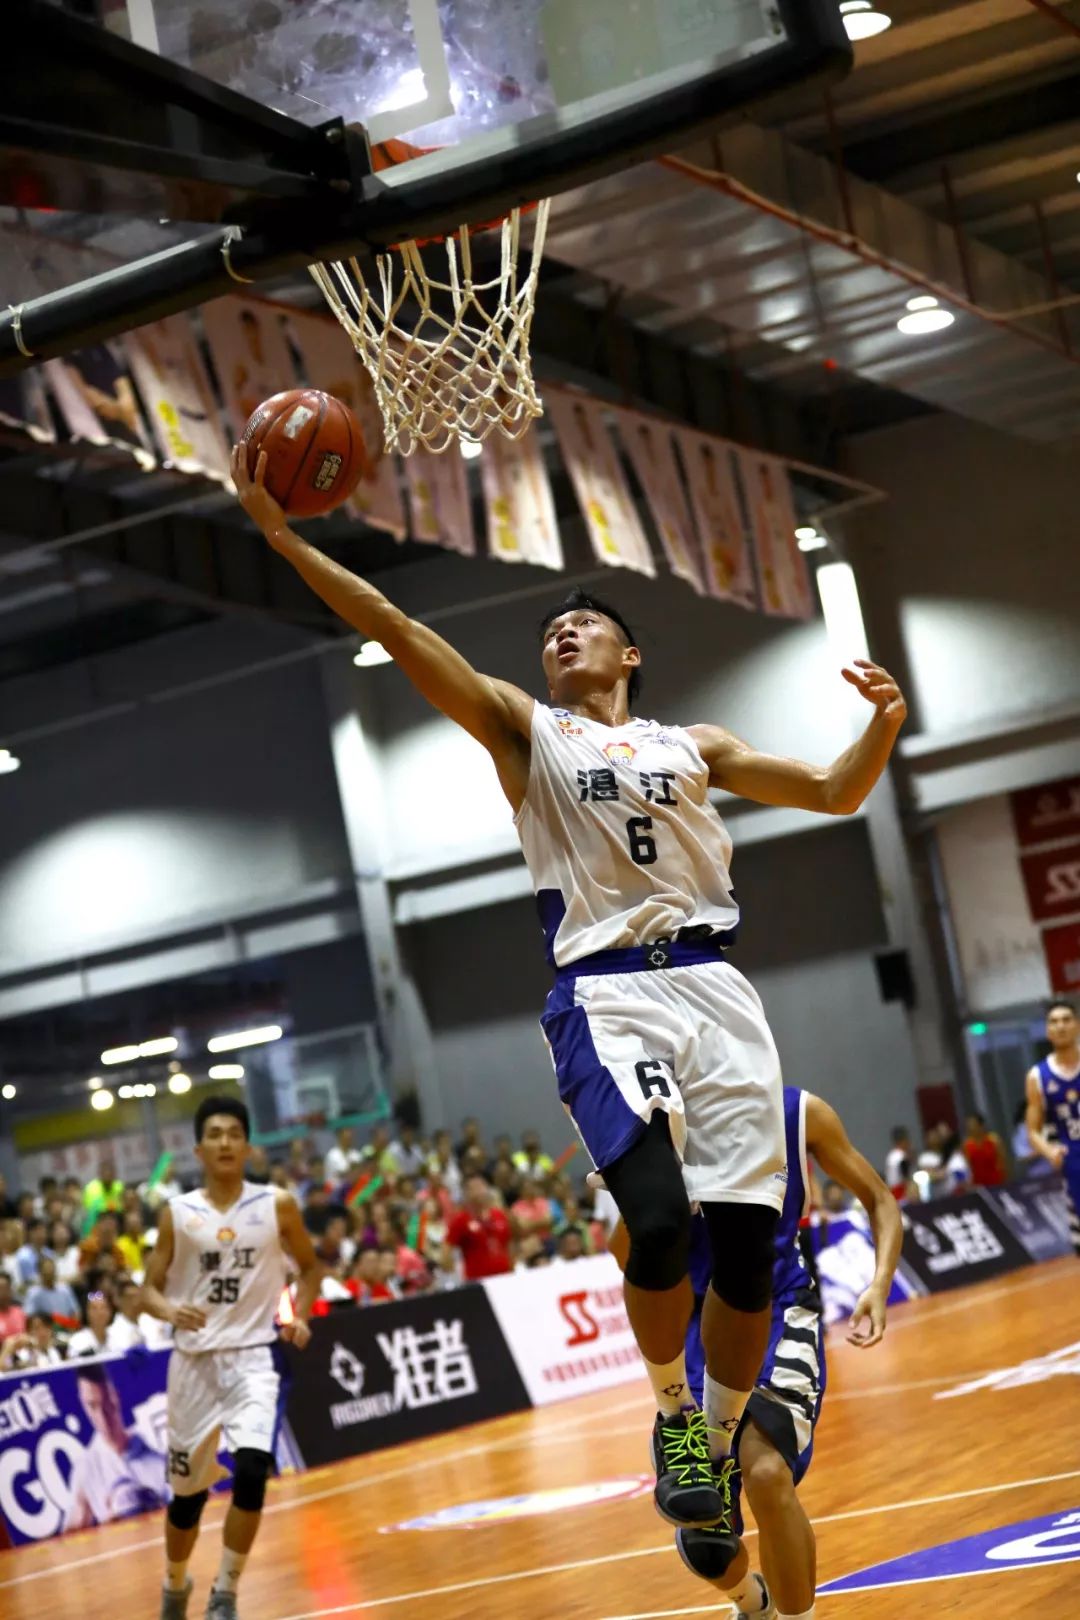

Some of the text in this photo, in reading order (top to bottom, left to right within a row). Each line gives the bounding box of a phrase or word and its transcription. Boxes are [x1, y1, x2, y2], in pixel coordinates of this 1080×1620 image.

[626, 816, 658, 865] 6
[634, 1060, 671, 1100] 6
[207, 1278, 239, 1303] 35
